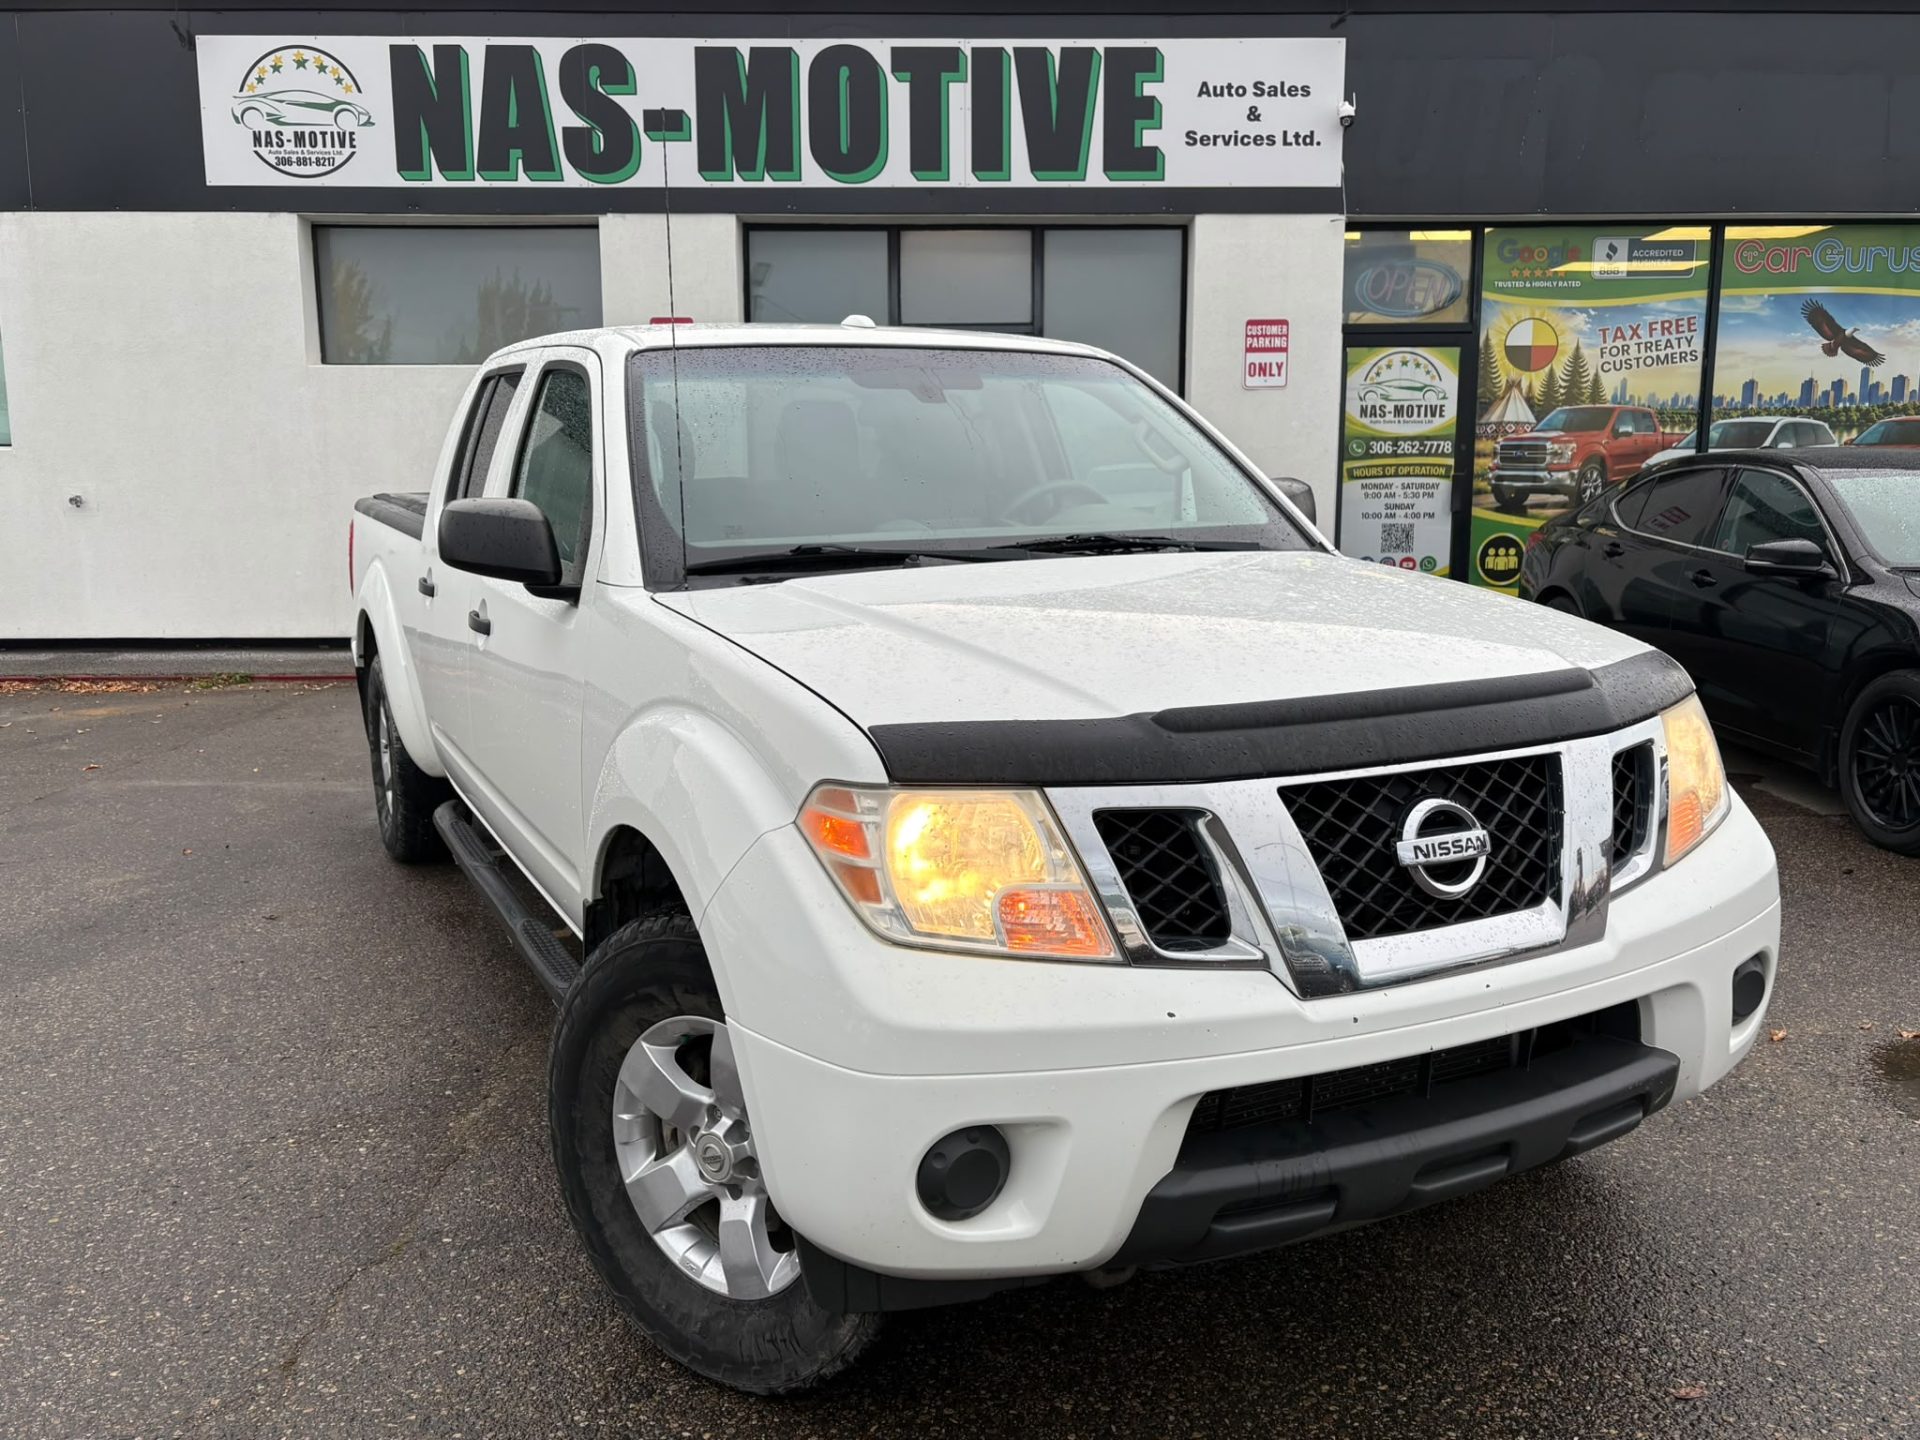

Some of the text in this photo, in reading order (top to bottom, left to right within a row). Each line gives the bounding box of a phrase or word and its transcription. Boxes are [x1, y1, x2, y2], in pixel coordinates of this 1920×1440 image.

[1197, 81, 1311, 97] Auto Sales
[389, 43, 1165, 185] NAS-MOTIVE
[1246, 105, 1262, 122] &
[252, 130, 357, 149] NAS-MOTIVE
[1185, 130, 1322, 147] Services Ltd.
[274, 156, 336, 167] 306-881-8217
[1497, 238, 1582, 266] Google
[1632, 249, 1684, 257] ACCREDITED
[1368, 266, 1450, 309] OPEN
[1494, 280, 1582, 288] TRUSTED & HIGHLY RATED
[1246, 324, 1288, 336] CUSTOMER
[1598, 316, 1698, 345] TAX FREE
[1246, 336, 1288, 348] PARKING
[1600, 335, 1694, 359] FOR TREATY
[1600, 349, 1699, 373] CUSTOMERS
[1247, 361, 1284, 378] ONLY
[1360, 404, 1446, 419] NAS-MOTIVE
[1369, 440, 1452, 454] 306-262-7778
[1353, 465, 1446, 477] HOURS OF OPERATION
[1360, 482, 1394, 490] MONDAY
[1400, 482, 1440, 490] SATURDAY
[1364, 491, 1382, 500] 9:00
[1383, 491, 1396, 499] AM
[1402, 491, 1420, 499] 5:30
[1422, 491, 1434, 499] PM
[1384, 503, 1415, 511] SUNDAY
[1361, 511, 1383, 520] 10:00
[1384, 511, 1396, 519] AM
[1403, 511, 1421, 519] 4:00
[1422, 511, 1435, 519] PM
[1413, 834, 1488, 860] NISSAN
